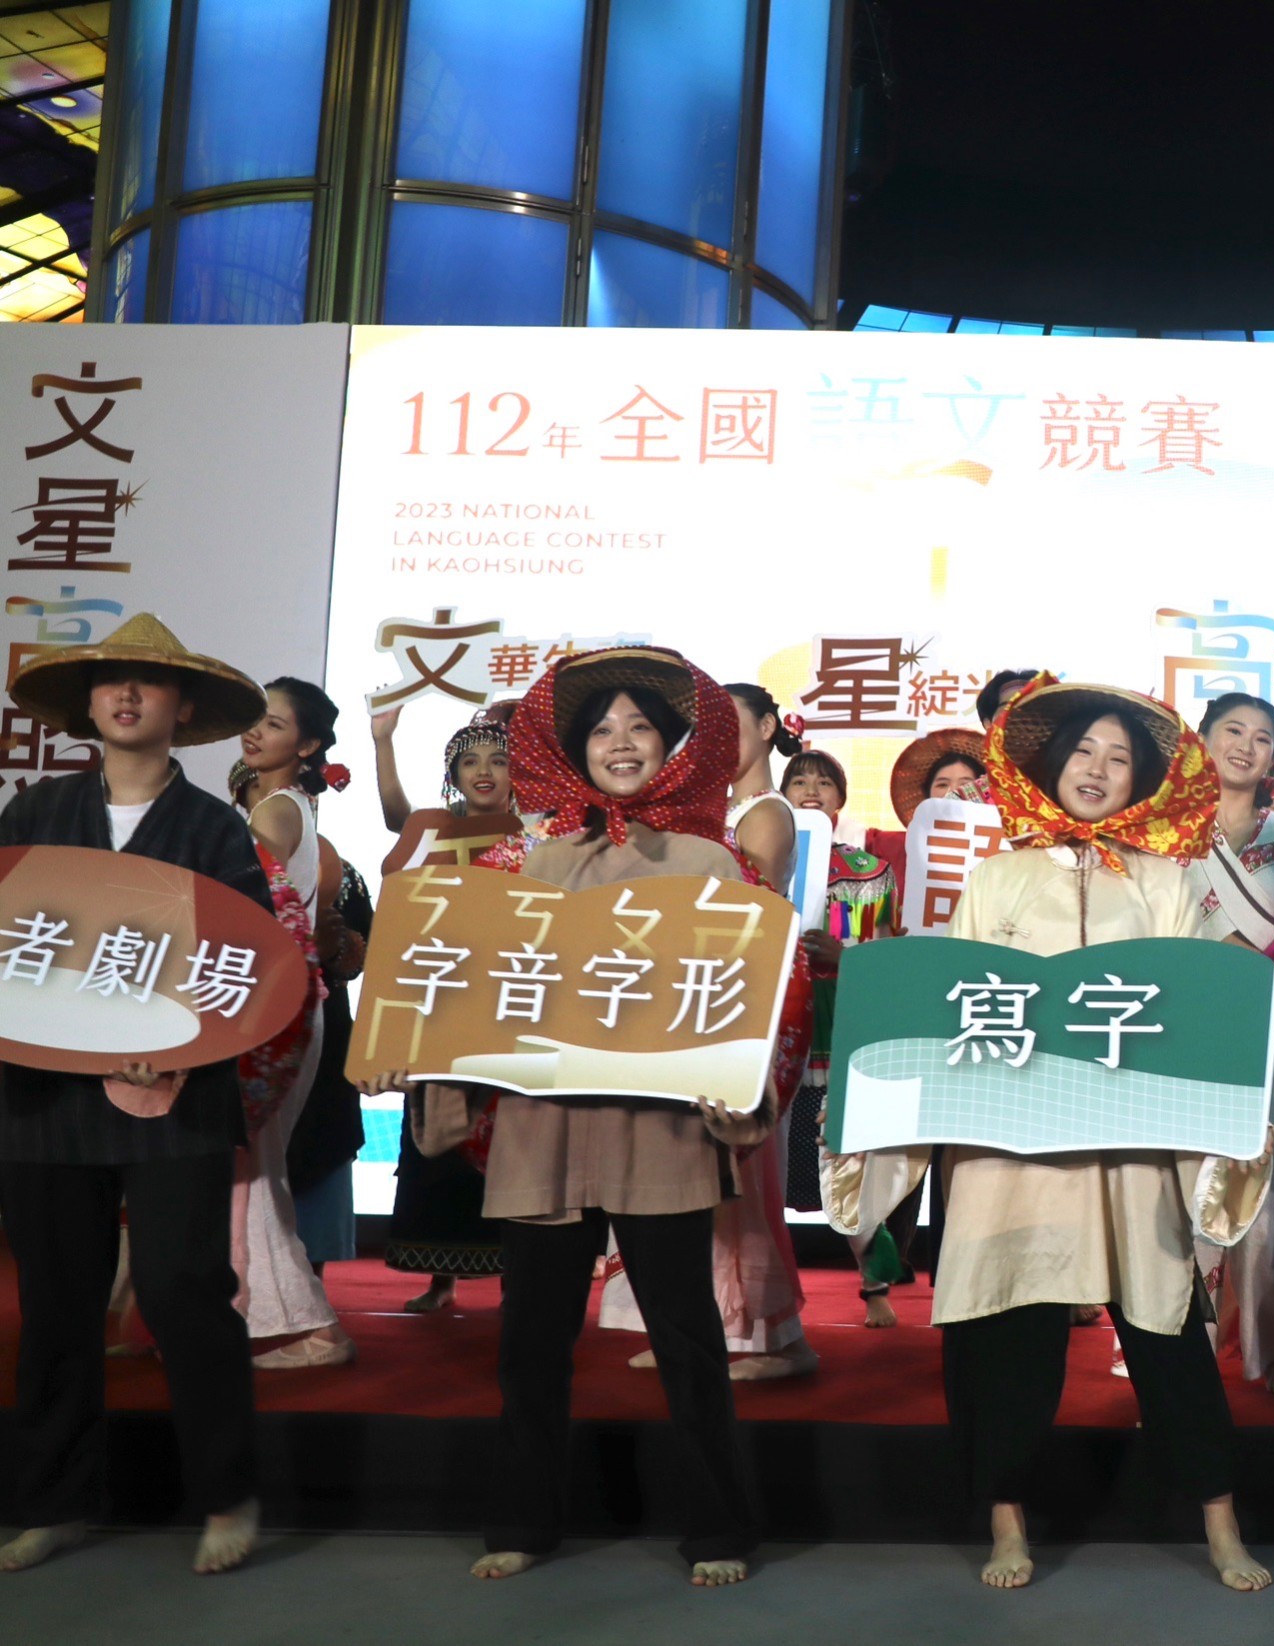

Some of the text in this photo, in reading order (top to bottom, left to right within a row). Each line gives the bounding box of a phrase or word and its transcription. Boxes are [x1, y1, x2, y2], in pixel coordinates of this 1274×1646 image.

[393, 530, 668, 549] LANGUAGE CONTEST
[395, 502, 596, 521] 2023 NATIONAL
[391, 556, 585, 575] IN KAOHSIUNG
[0, 911, 258, 1018] 者劇場
[396, 937, 747, 1035] 字音字形
[944, 972, 1164, 1069] 寫字
